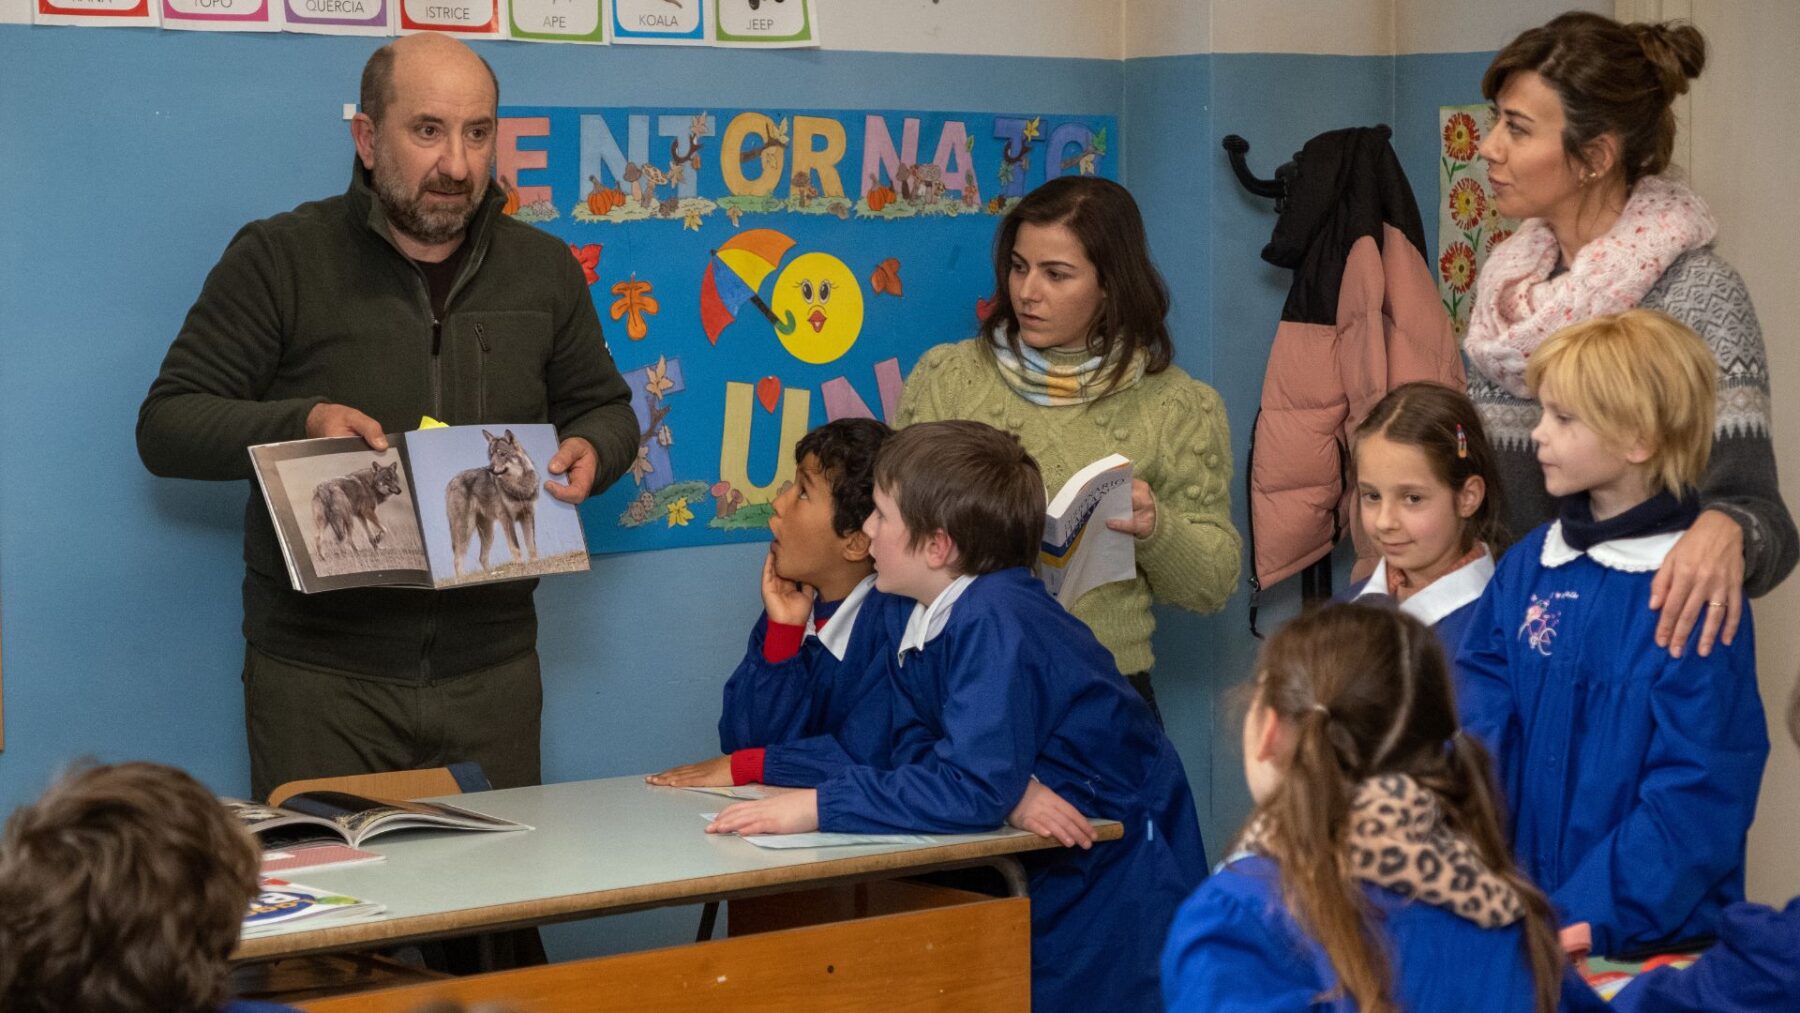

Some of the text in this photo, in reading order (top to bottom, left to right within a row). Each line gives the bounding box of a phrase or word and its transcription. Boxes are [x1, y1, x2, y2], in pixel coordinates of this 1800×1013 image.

[306, 0, 365, 14] QUERCIA
[425, 6, 470, 20] ISTRICE
[543, 16, 567, 28] APE
[638, 14, 679, 27] KOALA
[746, 19, 774, 31] JEEP
